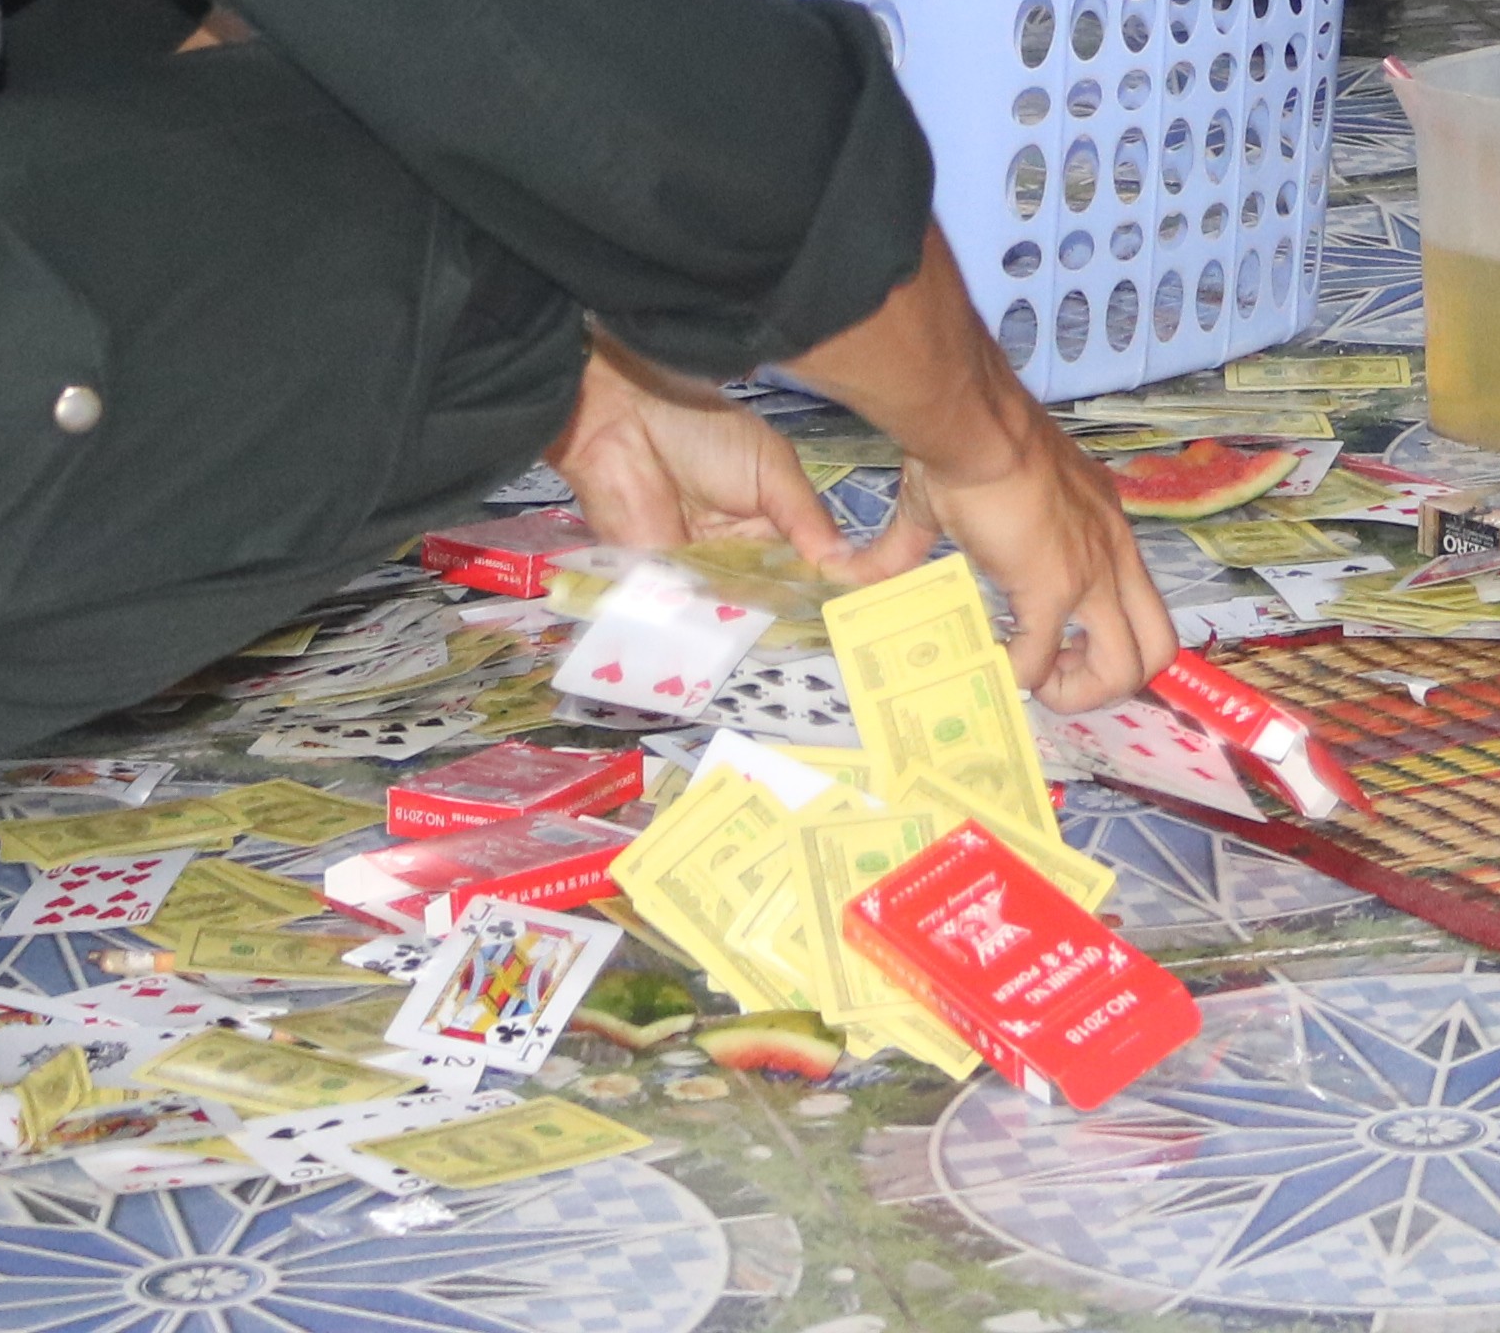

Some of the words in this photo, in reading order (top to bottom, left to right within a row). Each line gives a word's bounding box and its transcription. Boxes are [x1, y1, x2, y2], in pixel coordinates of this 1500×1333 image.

[394, 805, 446, 829] NO.2018
[469, 902, 496, 923] J
[991, 964, 1042, 1004] POKER
[1064, 988, 1140, 1046] NO.2018
[516, 1039, 545, 1063] J
